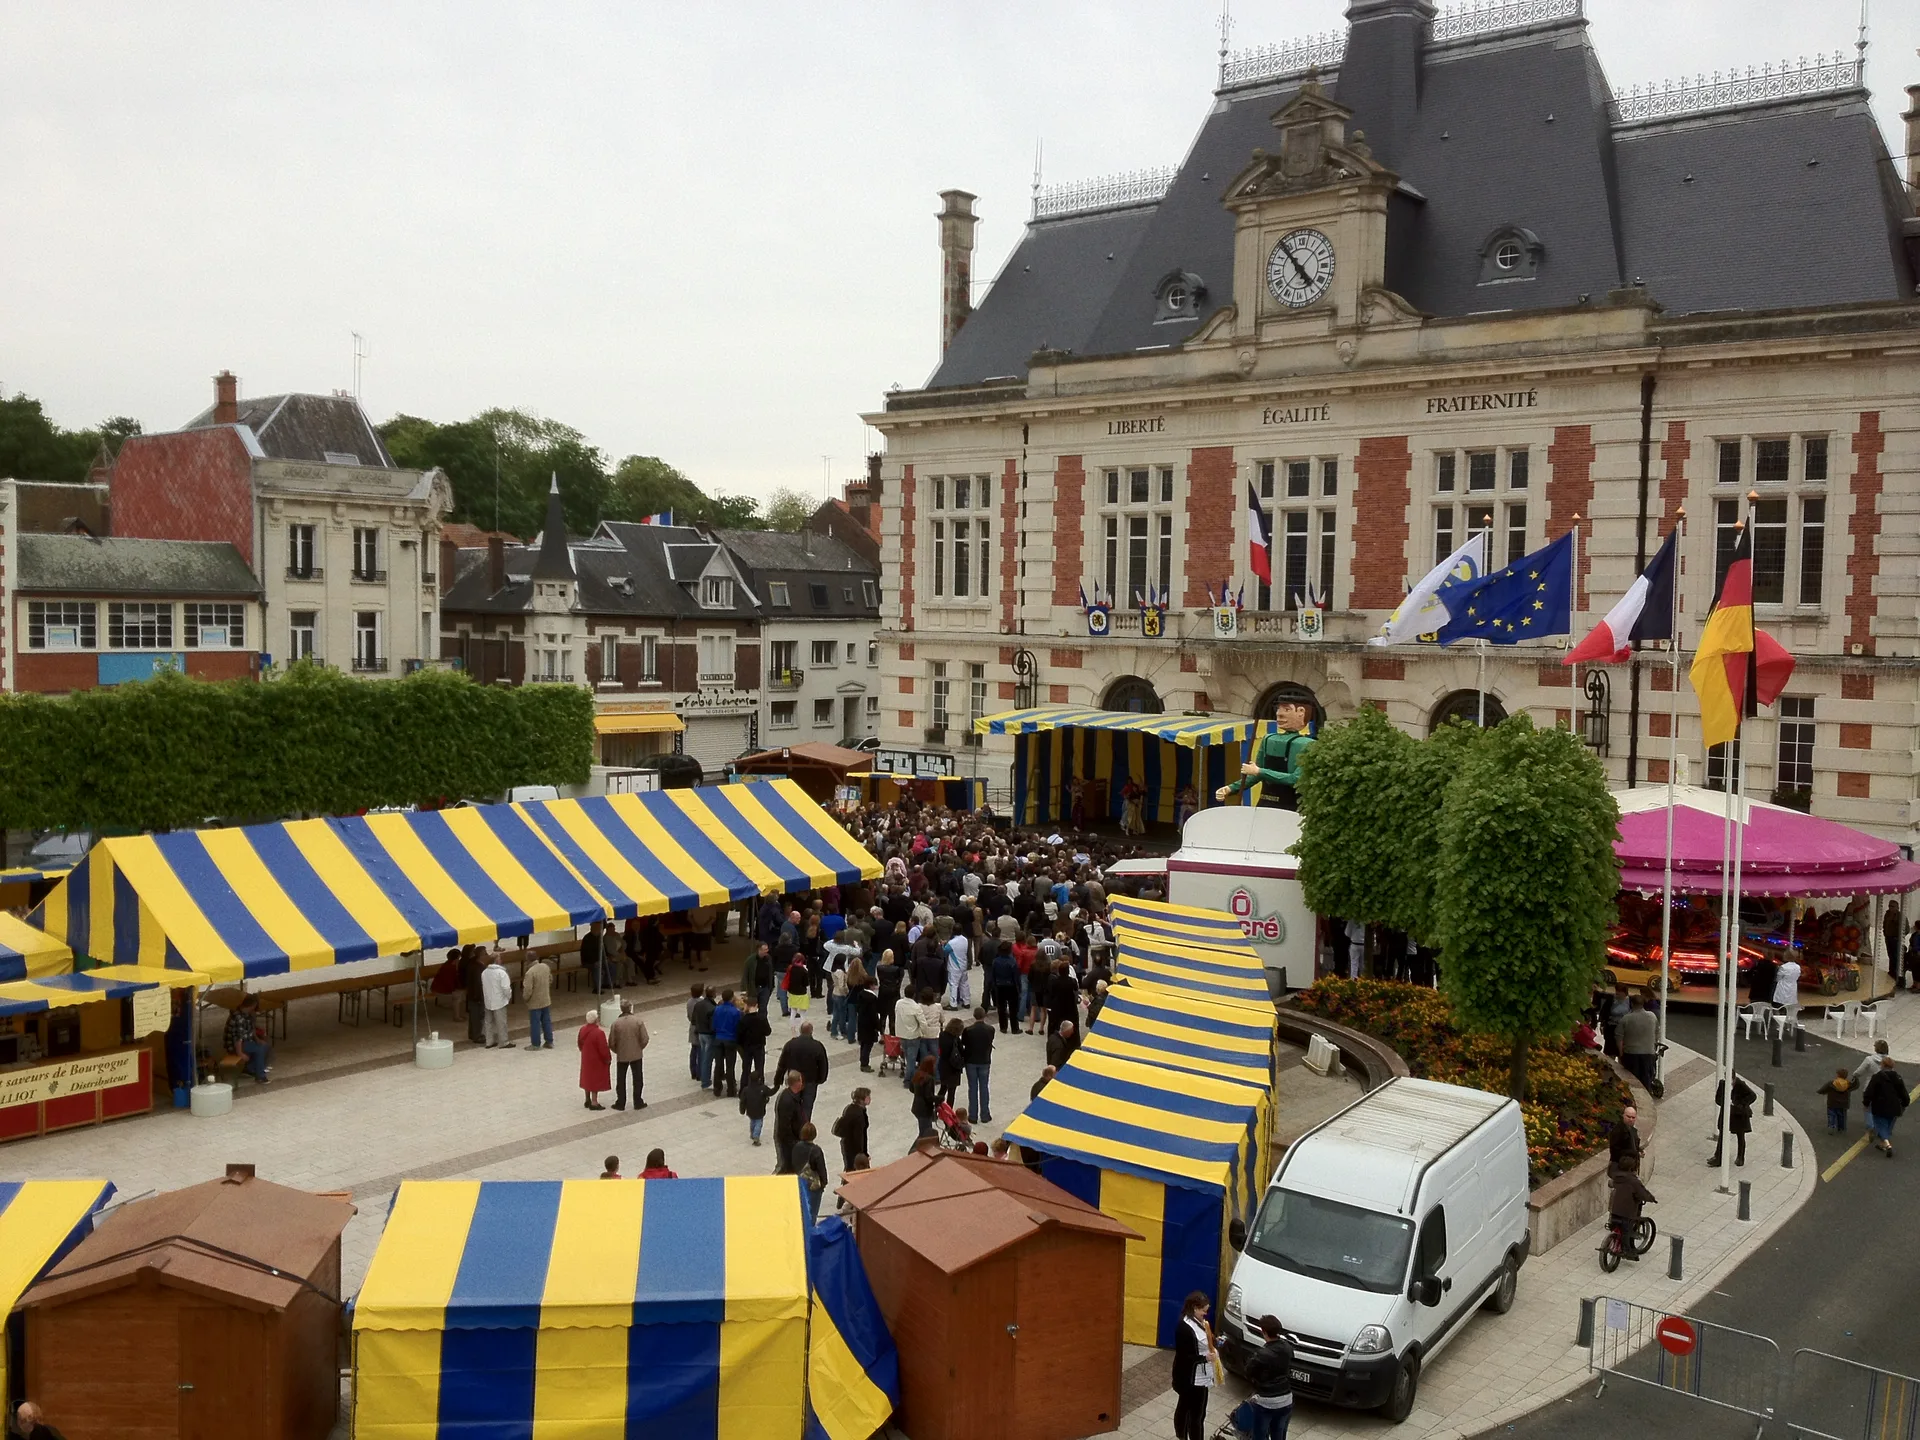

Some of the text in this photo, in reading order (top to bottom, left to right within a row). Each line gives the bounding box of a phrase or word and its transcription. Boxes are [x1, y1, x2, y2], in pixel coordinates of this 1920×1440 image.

[1426, 388, 1538, 413] FRATERNITÉ
[1108, 415, 1165, 435] LIBERTÉ
[1263, 403, 1330, 424] ÉGALITÉ
[1232, 890, 1251, 916] Ô
[1239, 917, 1278, 938] cré
[6, 1072, 50, 1087] saveurs
[52, 1066, 67, 1078] de
[70, 1058, 129, 1076] Bourgogne
[0, 1075, 129, 1104] LLIOT Distributeur
